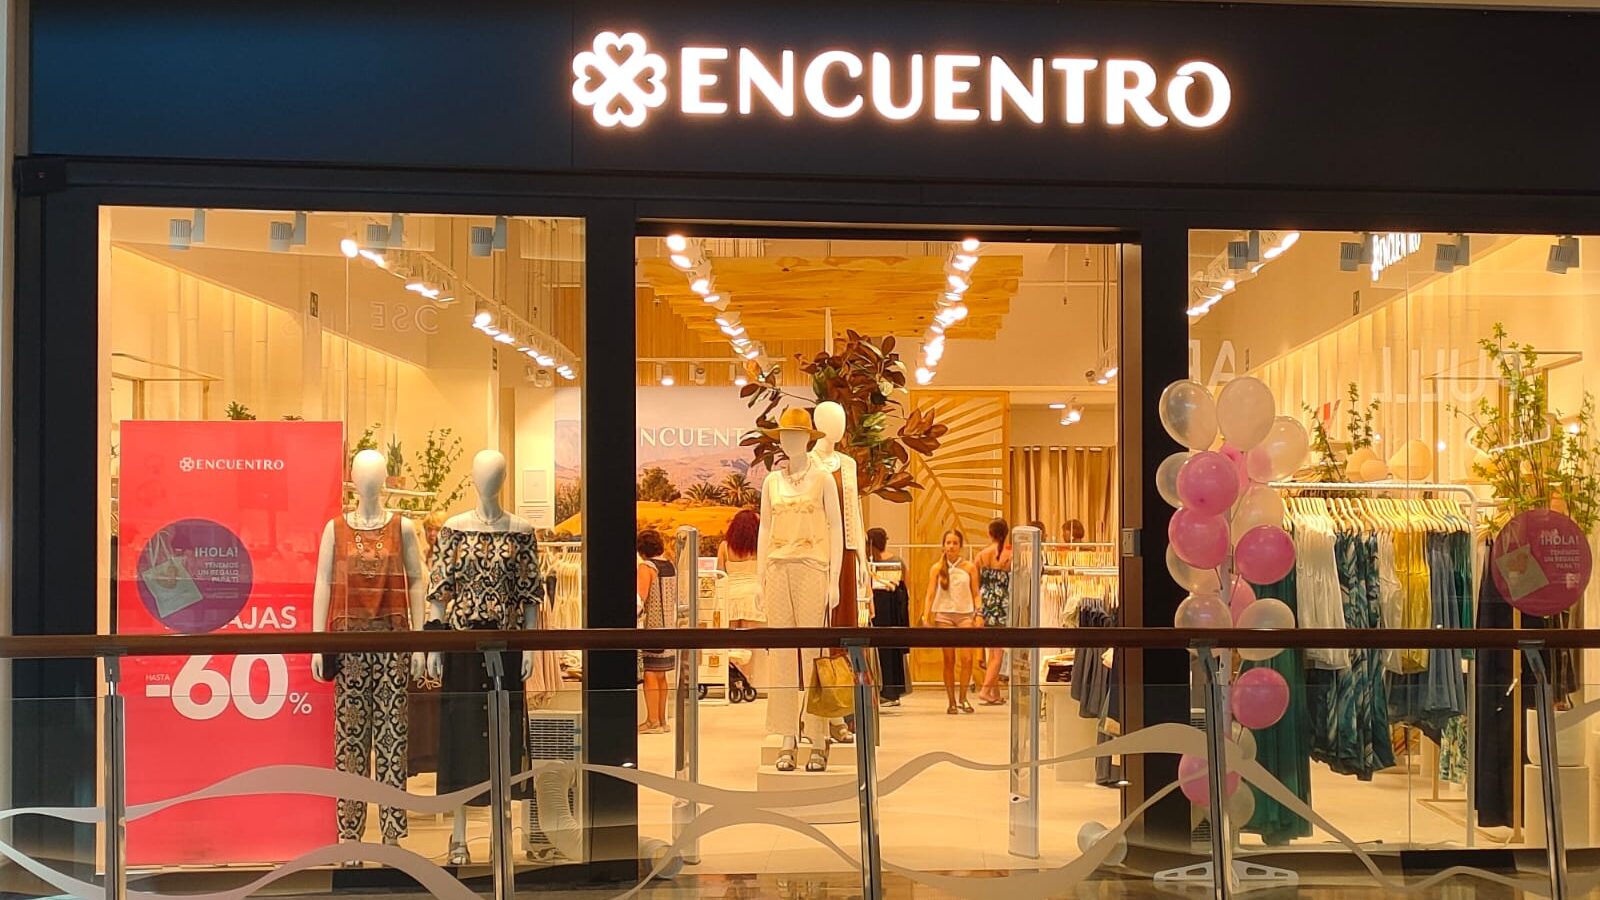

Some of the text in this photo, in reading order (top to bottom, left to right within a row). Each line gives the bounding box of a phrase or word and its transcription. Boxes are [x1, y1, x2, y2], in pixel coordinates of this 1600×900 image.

[680, 46, 1232, 128] ENCUENTRO
[640, 428, 746, 447] NCUENT
[196, 458, 285, 471] ENCUENTRO
[146, 674, 171, 682] HASTA
